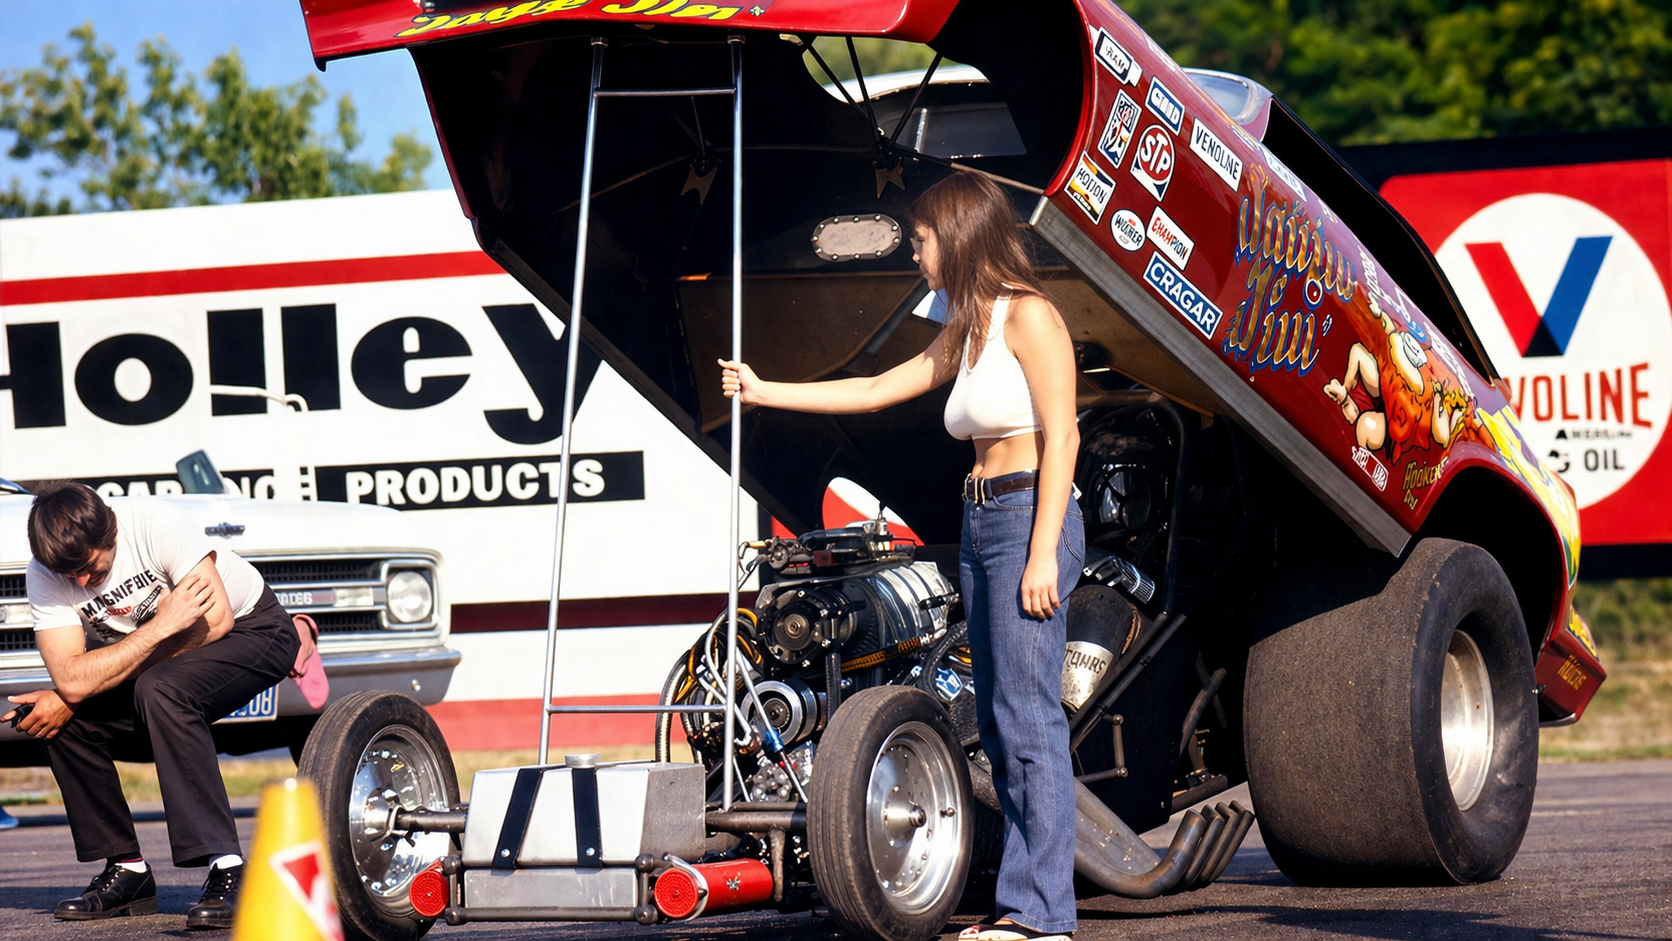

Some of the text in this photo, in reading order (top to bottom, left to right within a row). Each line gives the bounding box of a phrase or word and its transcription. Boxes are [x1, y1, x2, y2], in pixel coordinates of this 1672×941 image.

[1140, 132, 1172, 175] STP
[1150, 262, 1216, 331] CRAGAR
[0, 303, 603, 445] Holley
[346, 459, 605, 505] PRODUCTS
[1584, 448, 1625, 472] OIL
